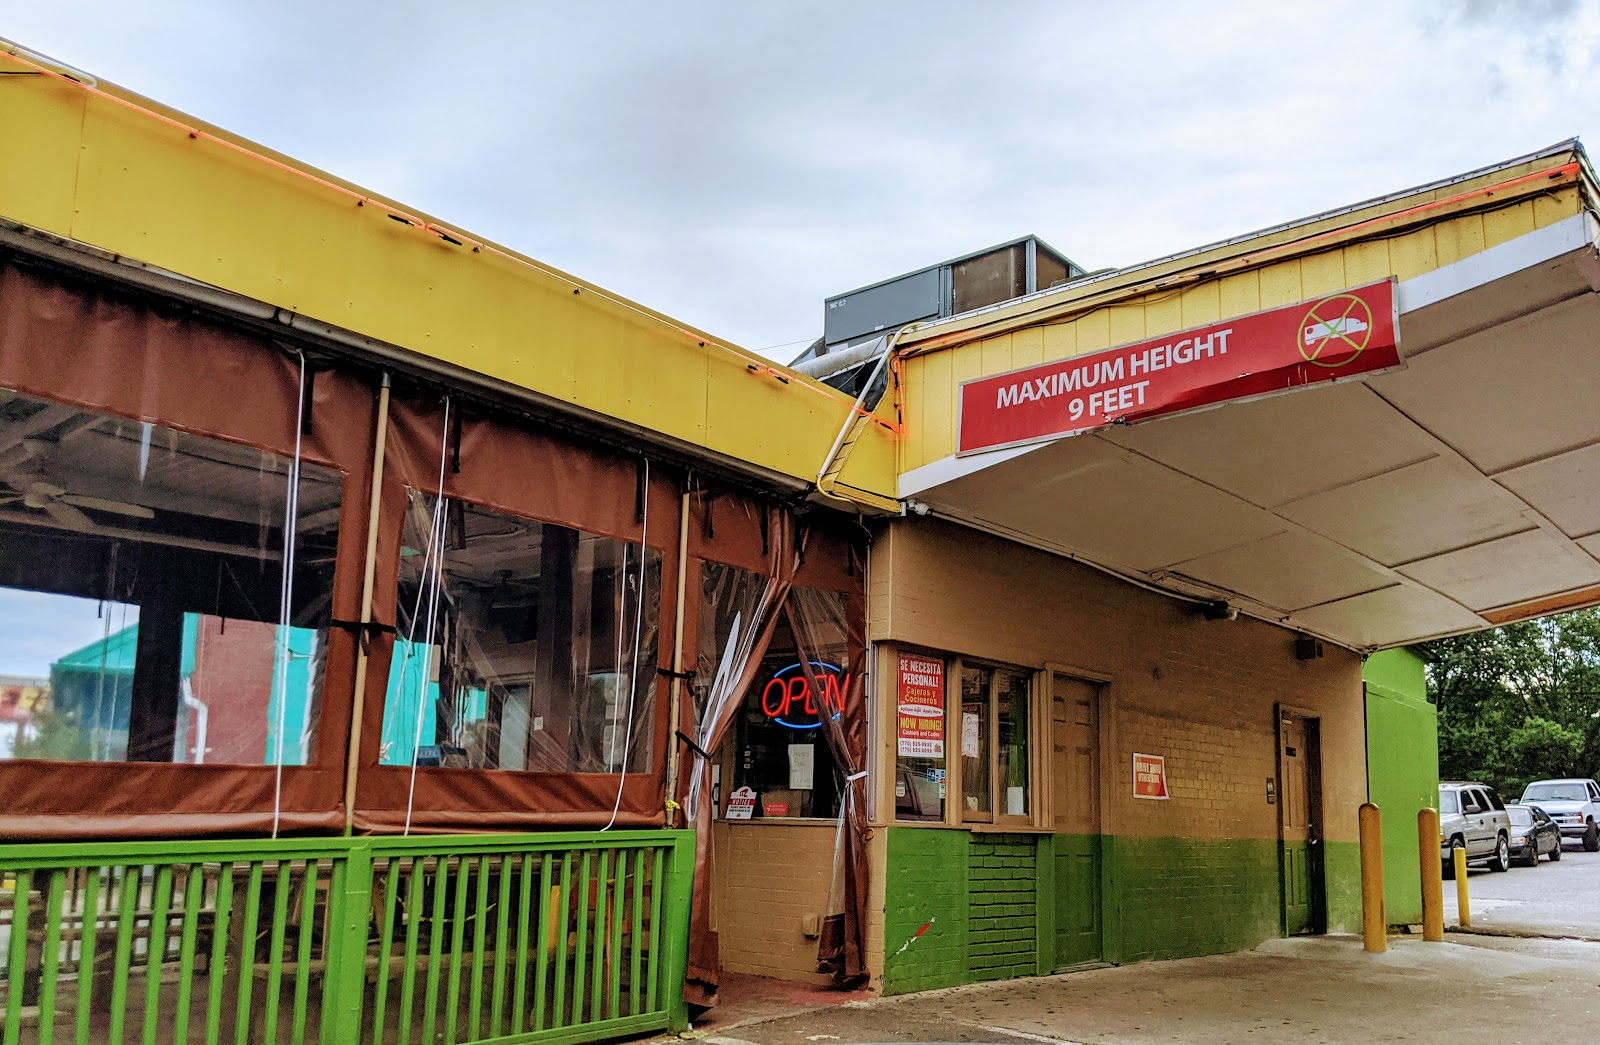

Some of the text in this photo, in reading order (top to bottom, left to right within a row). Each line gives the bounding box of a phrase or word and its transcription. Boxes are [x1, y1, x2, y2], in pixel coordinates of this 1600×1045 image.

[996, 328, 1234, 410] MAXIMUM HEIGHT
[1068, 380, 1150, 421] 9 FEET
[900, 659, 941, 675] SE NECESITA
[902, 673, 938, 688] PERSONAL!
[762, 674, 851, 717] OPEN
[905, 694, 937, 705] Cocineros
[906, 686, 936, 699] Cajeras y
[900, 717, 942, 732] NOW HIRING!
[903, 729, 919, 737] Cashiers
